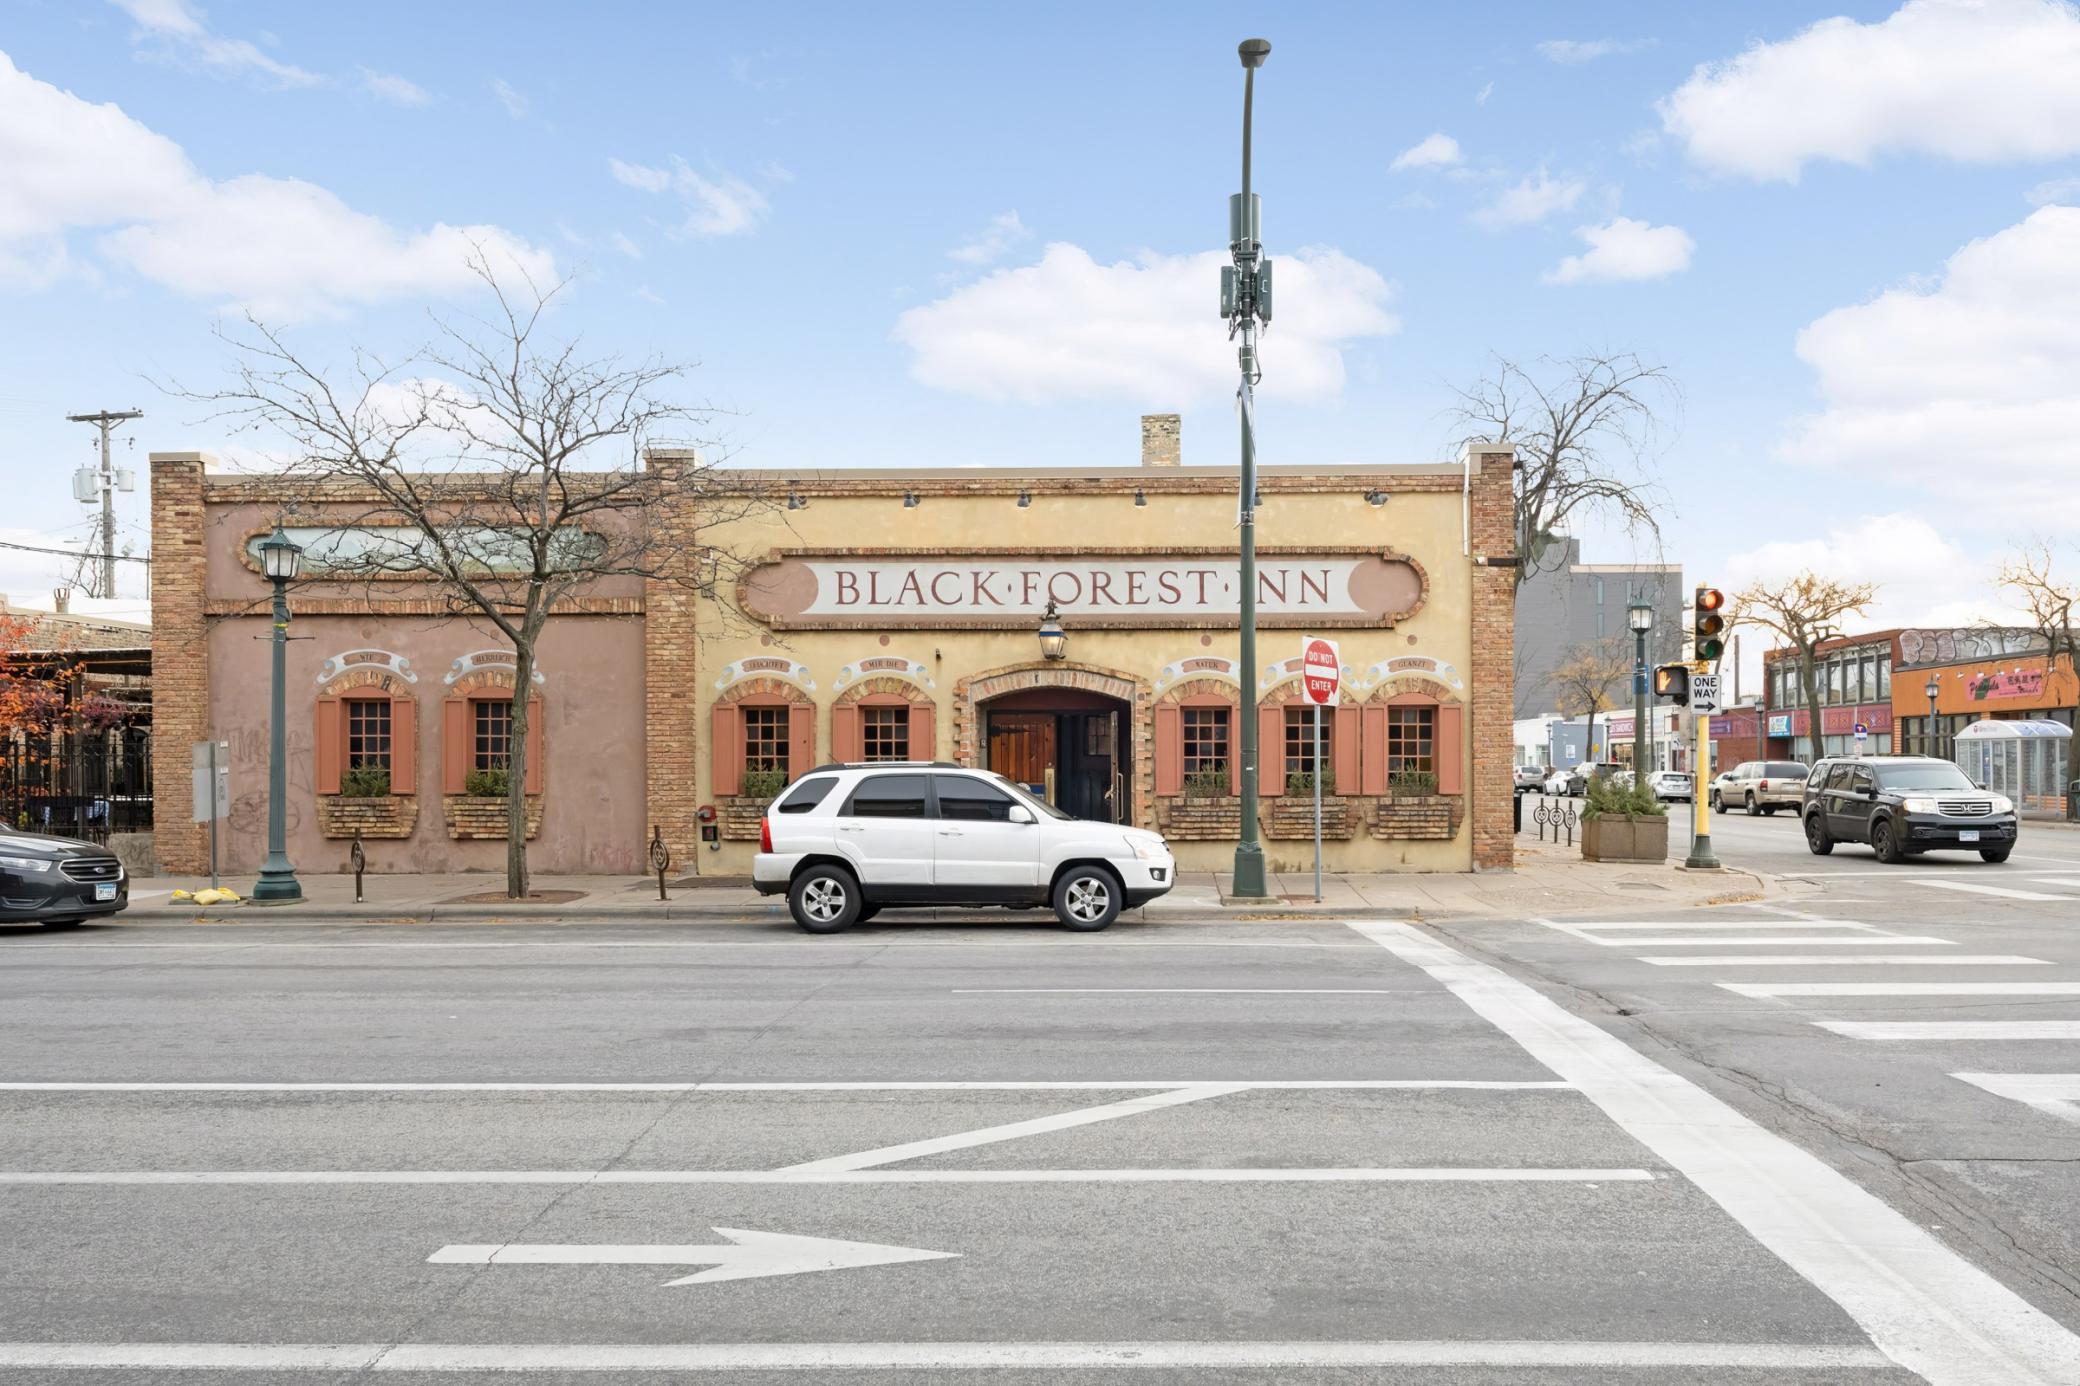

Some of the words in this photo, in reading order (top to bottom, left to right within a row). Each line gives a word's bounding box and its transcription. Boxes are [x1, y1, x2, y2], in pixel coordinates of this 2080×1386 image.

[835, 569, 1005, 606] BLACK
[1020, 570, 1218, 606] FOREST
[1237, 569, 1331, 605] NN
[1309, 651, 1318, 661] DO
[1320, 652, 1333, 664] NOT
[1311, 679, 1331, 692] ENTER
[1694, 677, 1717, 687] ONE
[1694, 688, 1717, 698] WAY
